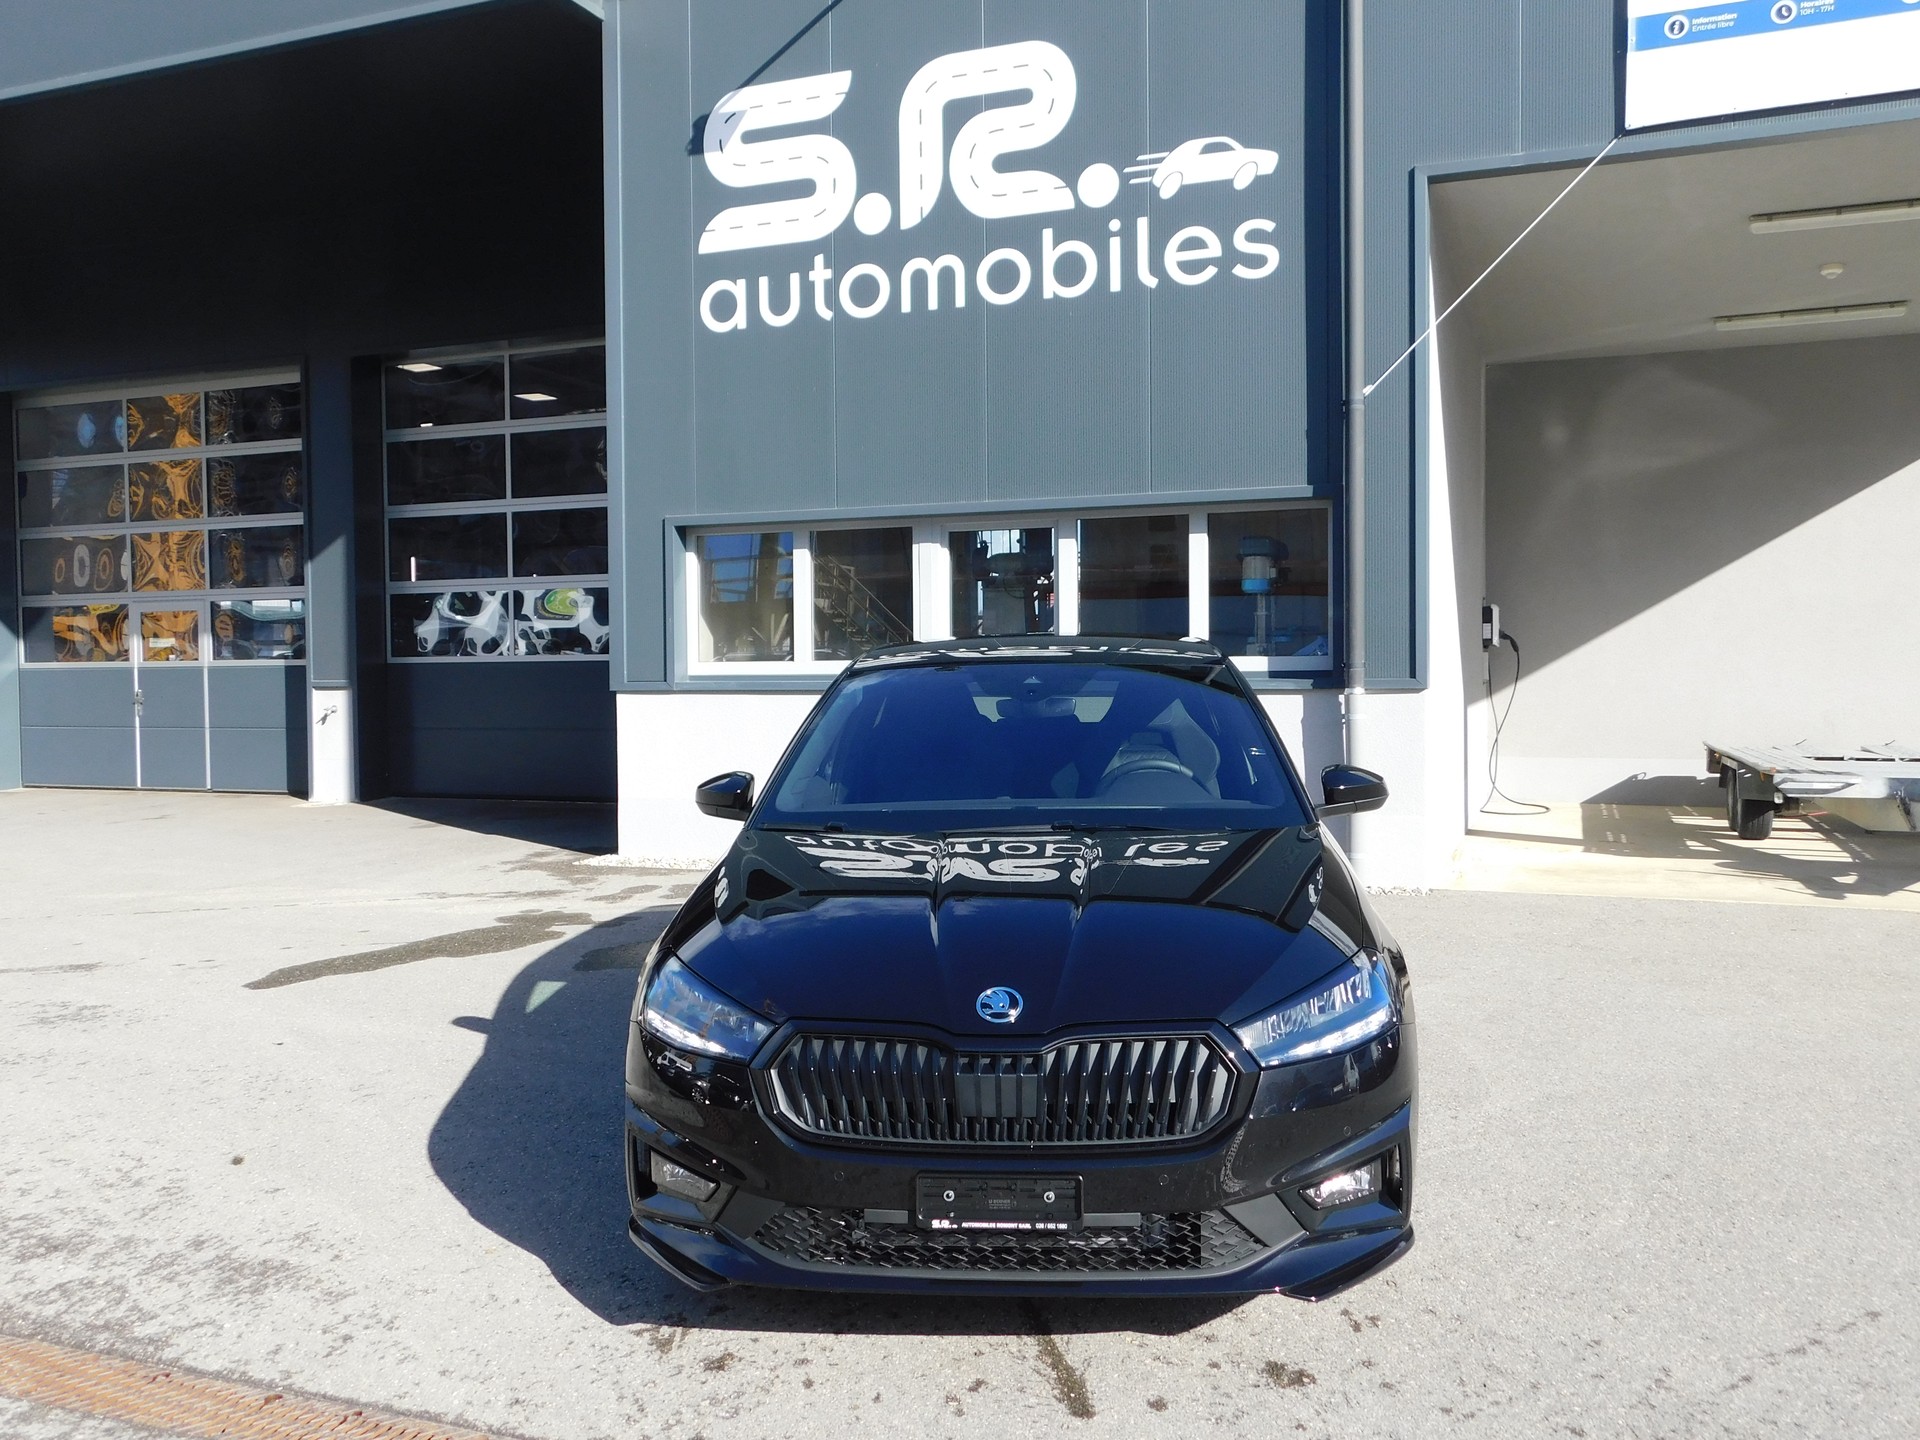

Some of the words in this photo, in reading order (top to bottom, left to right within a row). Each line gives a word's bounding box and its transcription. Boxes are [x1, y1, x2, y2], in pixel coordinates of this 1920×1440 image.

[1692, 13, 1738, 25] Information
[1800, 8, 1815, 16] 10H
[1820, 5, 1835, 13] 17H
[698, 40, 1120, 255] S.R.
[699, 216, 1280, 333] automobiles
